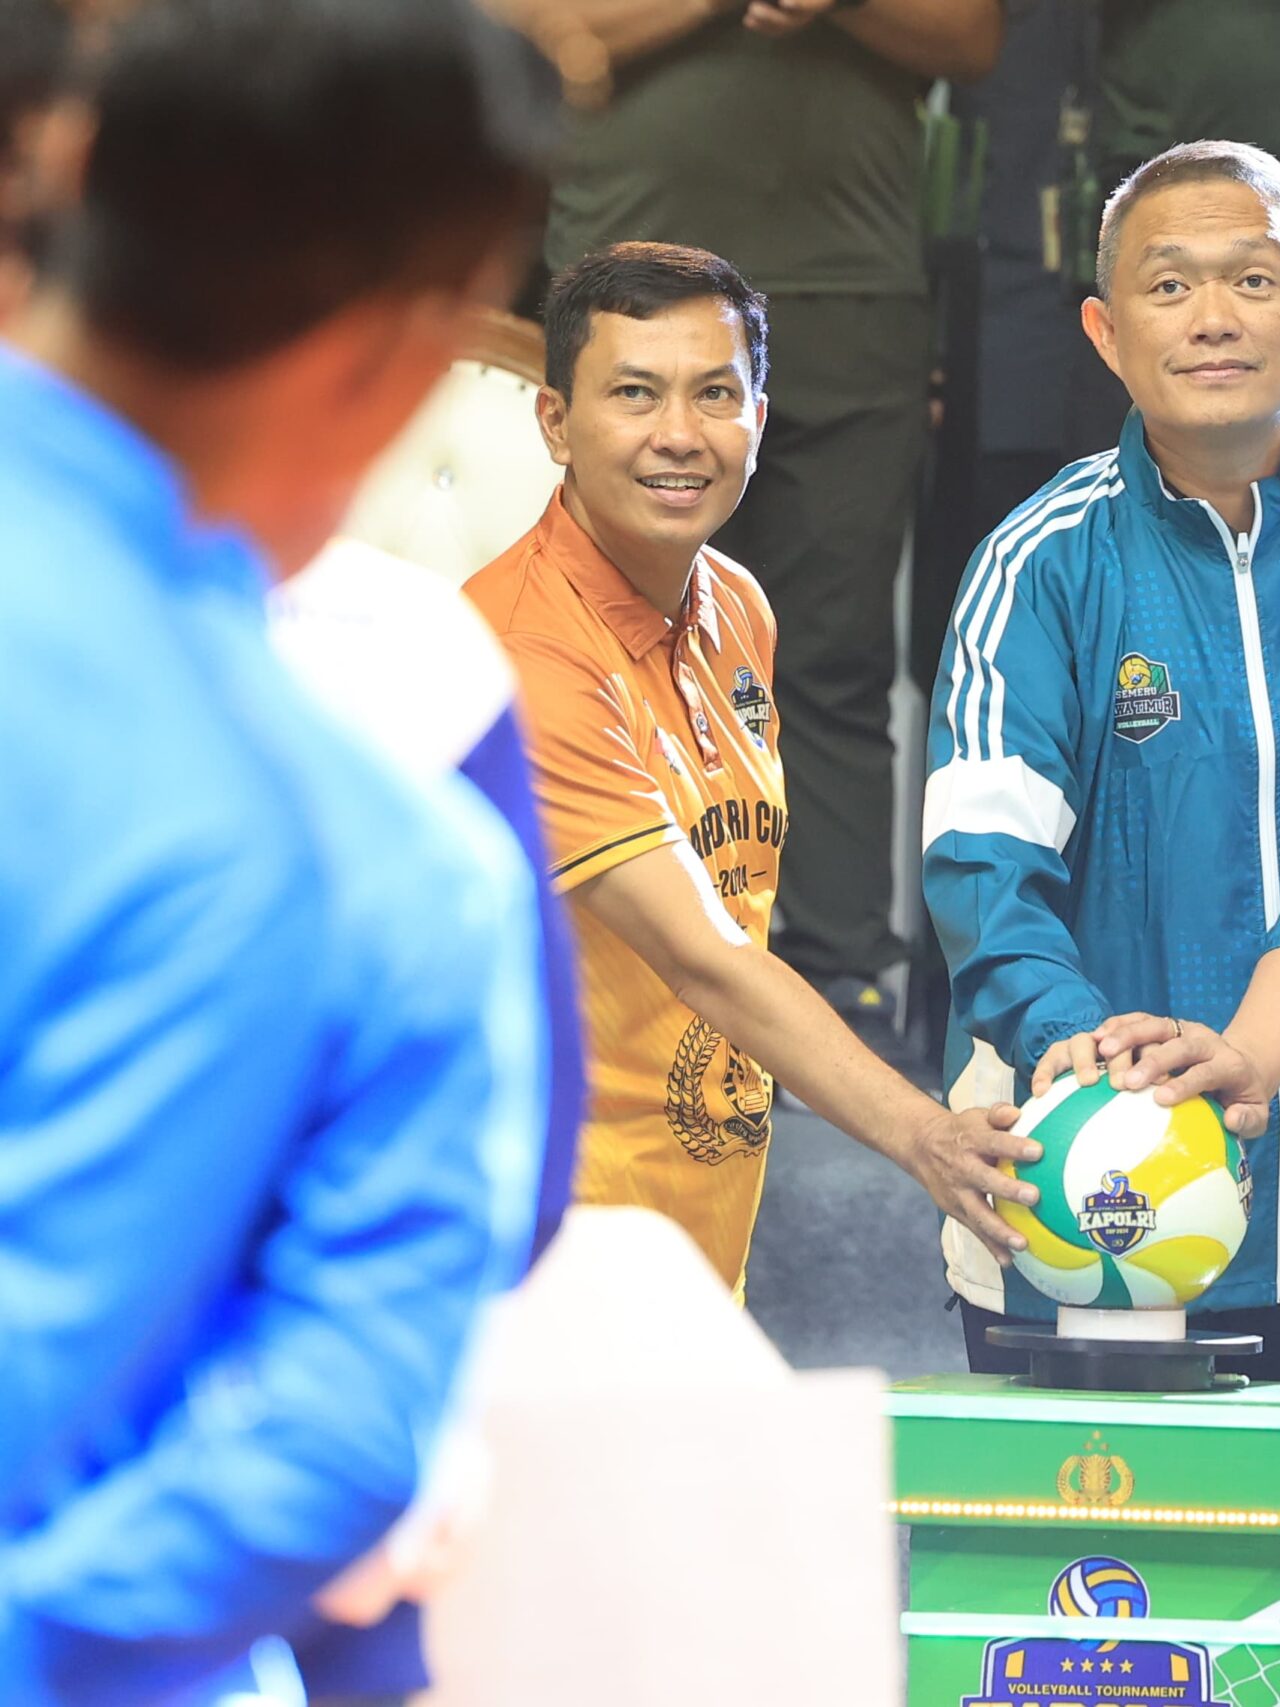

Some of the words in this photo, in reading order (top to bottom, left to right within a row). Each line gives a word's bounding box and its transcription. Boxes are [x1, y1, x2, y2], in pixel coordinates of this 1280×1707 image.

[1115, 687, 1157, 699] SEMERU
[1134, 696, 1174, 716] TIMUR
[1079, 1211, 1156, 1232] KAPOLRI
[1008, 1683, 1092, 1697] VOLLEYBALL
[1096, 1685, 1186, 1699] TOURNAMENT
